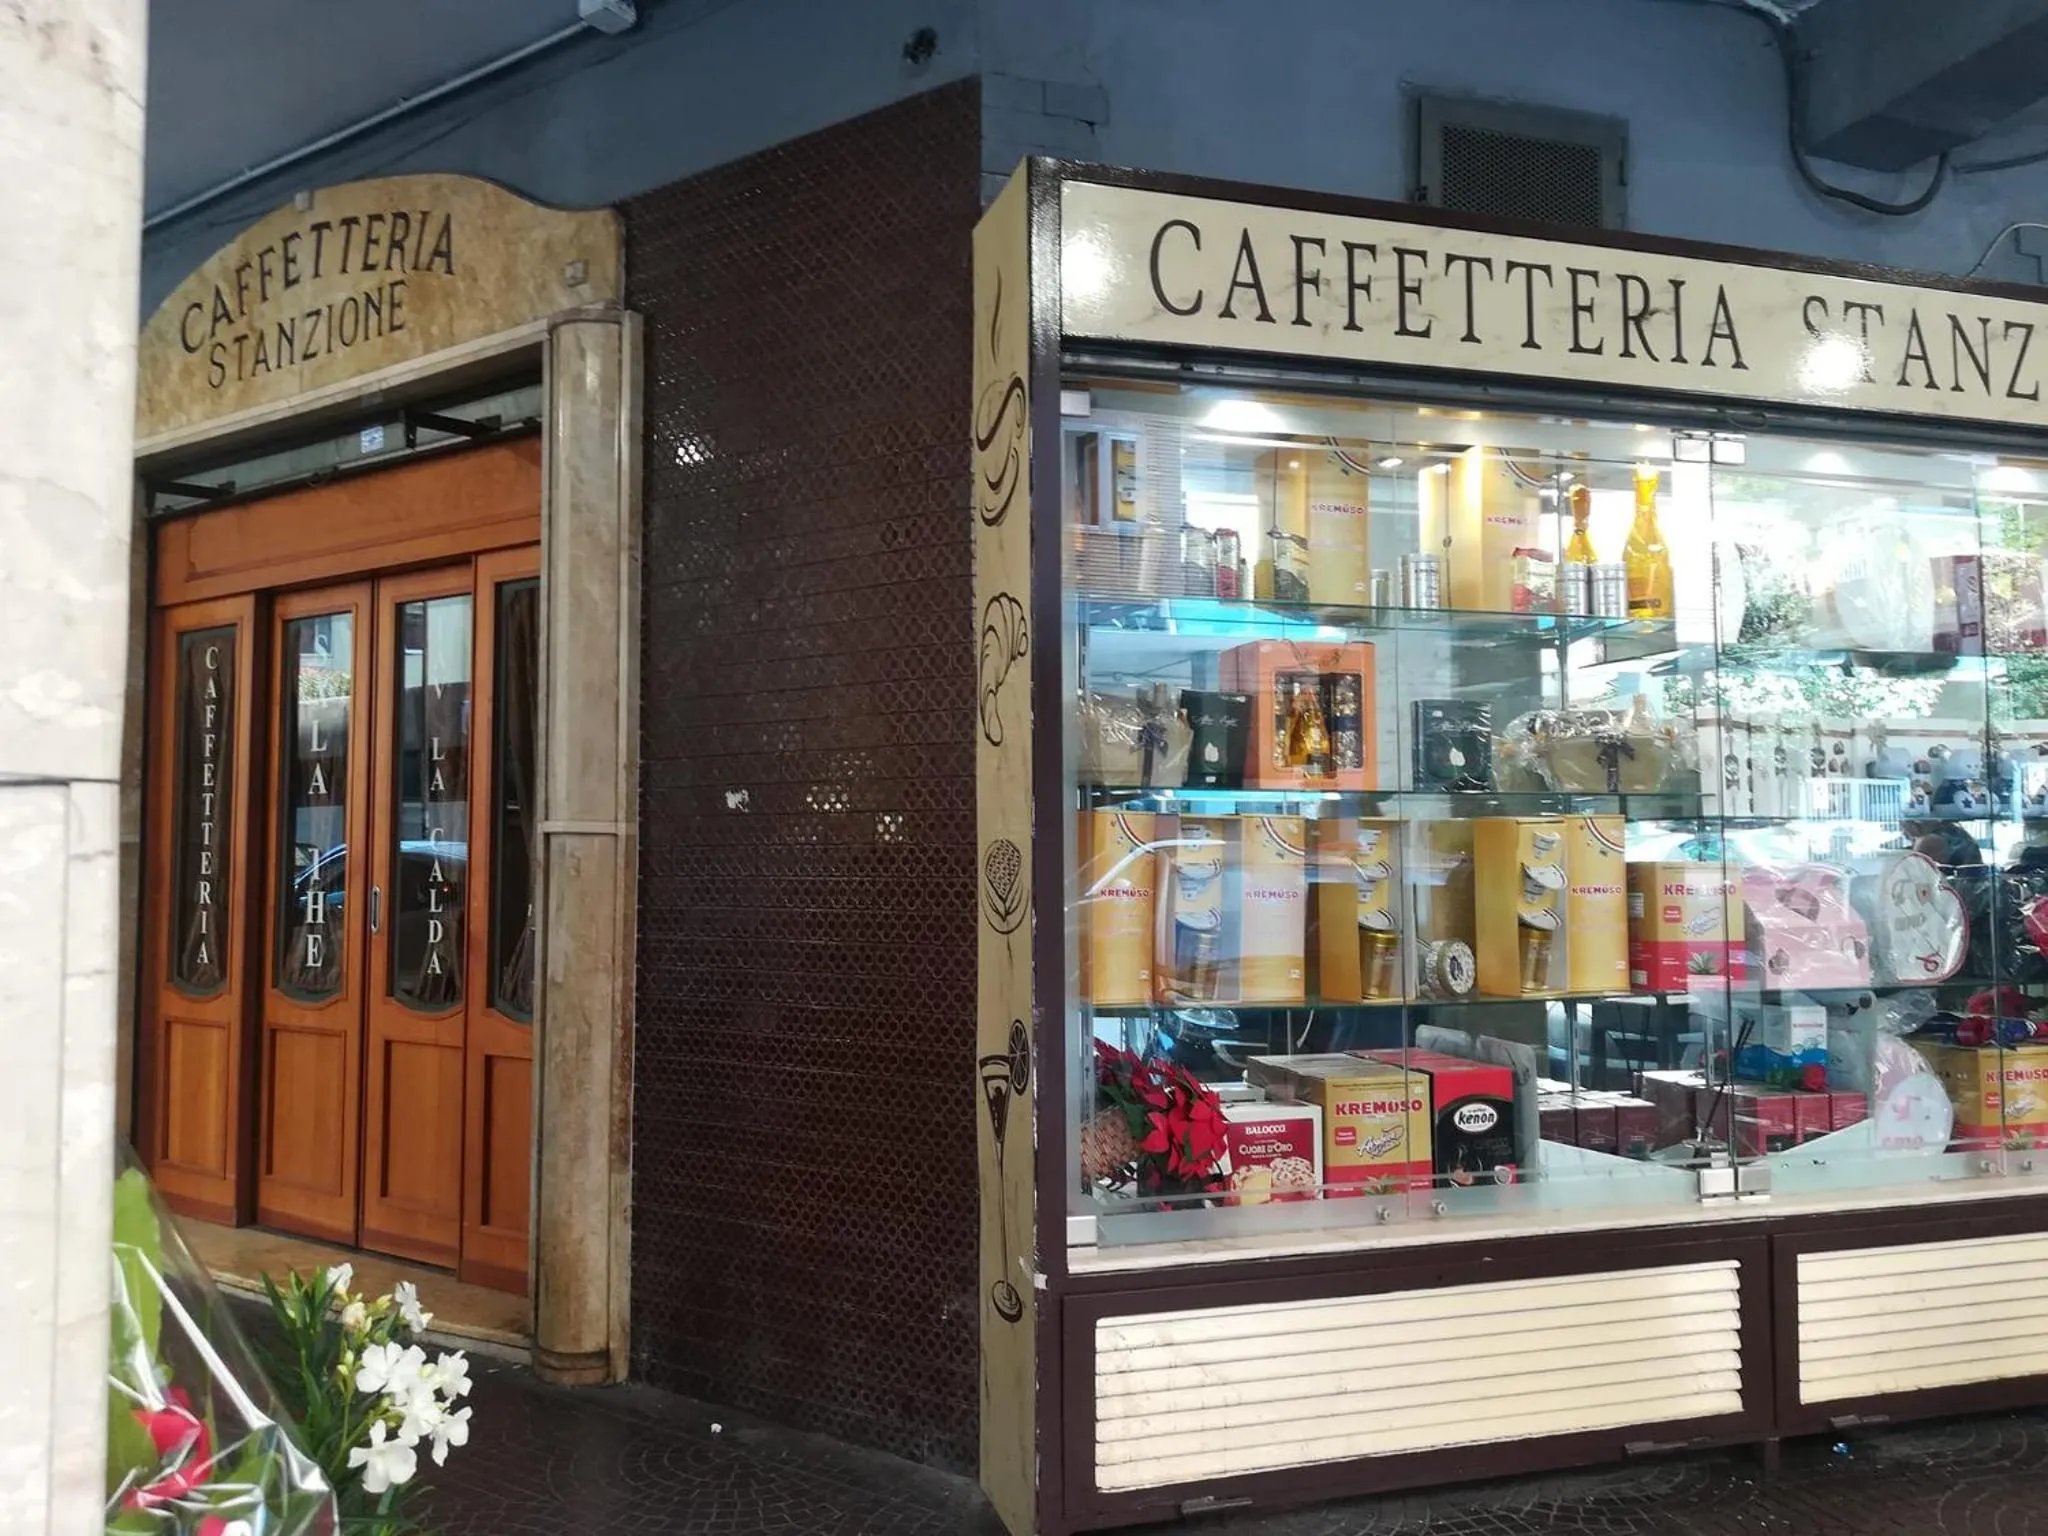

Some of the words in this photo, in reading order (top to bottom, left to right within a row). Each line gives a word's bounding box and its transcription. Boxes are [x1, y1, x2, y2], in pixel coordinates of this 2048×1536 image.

[180, 209, 456, 355] CAFFETTERIA
[207, 278, 410, 390] STANZIONE
[1149, 218, 1750, 371] CAFFETTERIA
[195, 645, 220, 966] CAFFETTERIA
[304, 846, 328, 970] THE
[425, 826, 447, 976] CALDA
[1245, 1124, 1286, 1135] BALOCCO
[1457, 1111, 1495, 1126] kenon
